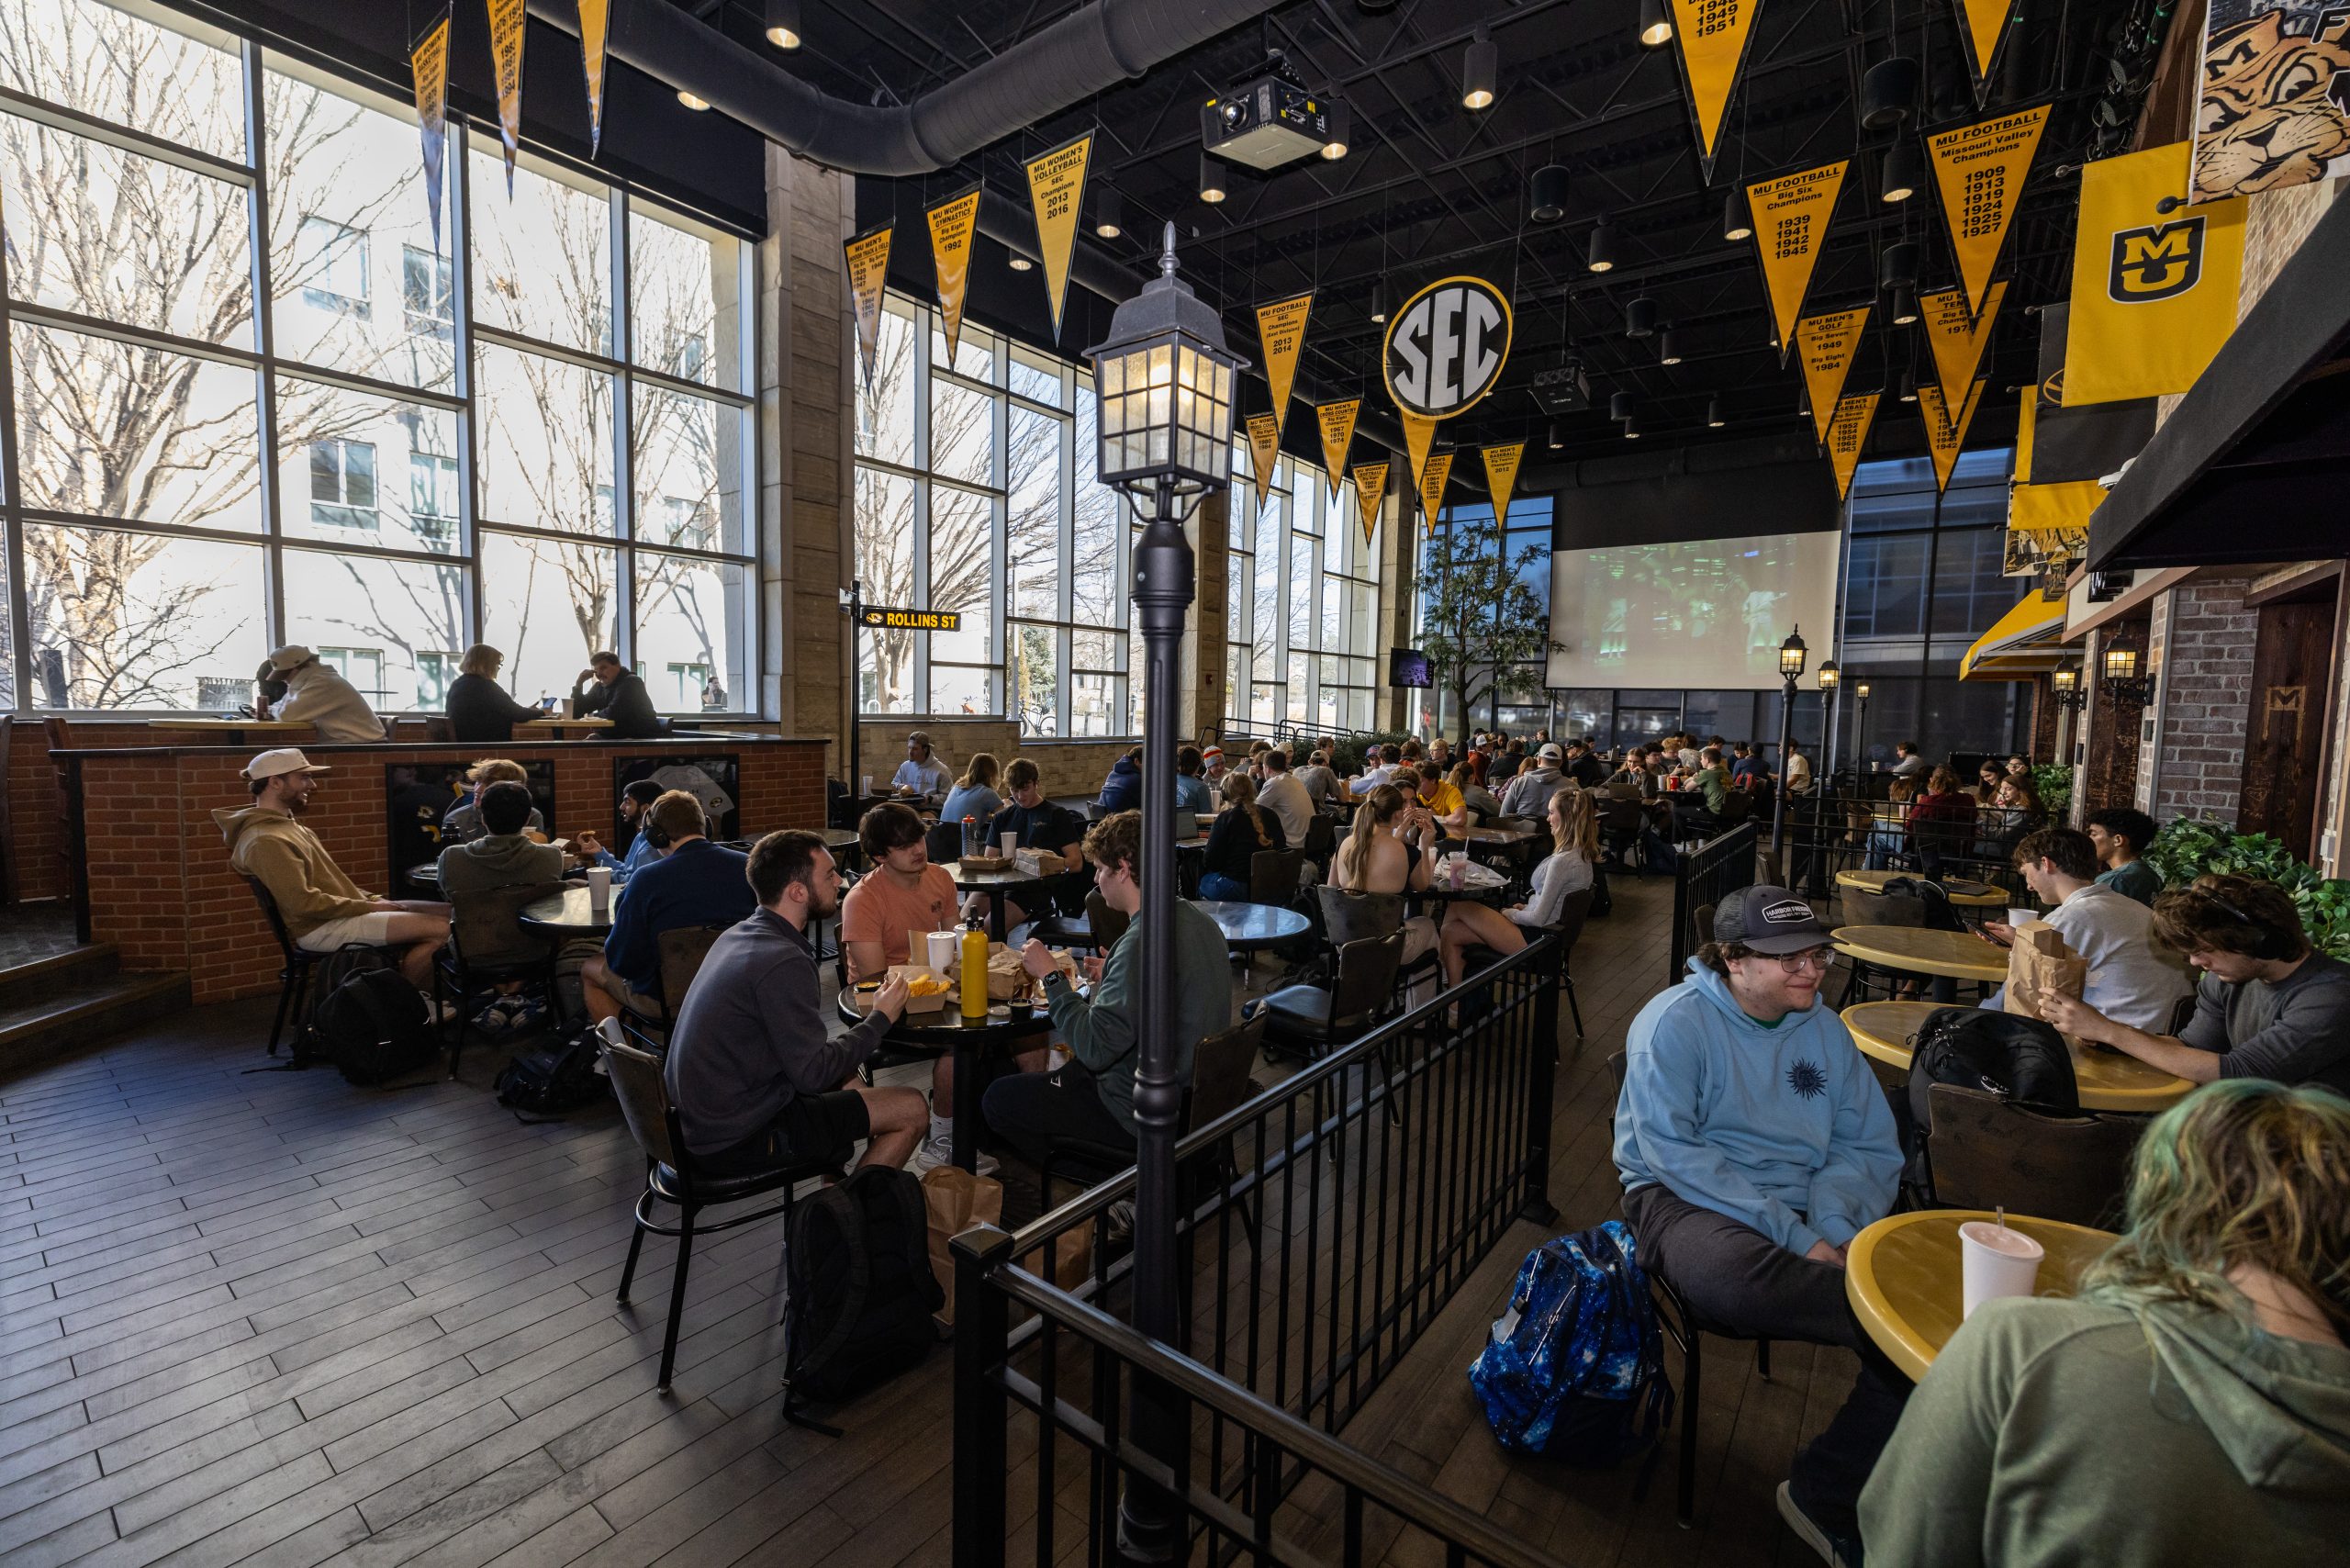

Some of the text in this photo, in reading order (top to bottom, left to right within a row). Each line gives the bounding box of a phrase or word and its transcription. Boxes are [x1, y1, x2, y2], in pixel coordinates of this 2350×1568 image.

[1697, 0, 1737, 15] 194
[1696, 4, 1739, 27] 1949
[1696, 16, 1736, 38] 1951
[1936, 112, 2042, 147] MU FOOTBALL
[1941, 129, 2033, 159] Missouri Valley
[1034, 145, 1083, 174] MU WOMEN'S
[1953, 142, 2020, 164] Champions
[1034, 155, 1083, 182] VOLLEYBALL
[1965, 165, 2006, 183] 1909
[1051, 174, 1064, 185] SEC
[1753, 167, 1841, 196] MU FOOTBALL
[1964, 177, 2005, 195] 1913
[1040, 180, 1075, 199] Champions
[1778, 191, 1794, 199] Big
[1964, 188, 2004, 206] 1919
[1046, 192, 1069, 208] 2013
[1767, 193, 1823, 210] Champions
[933, 198, 973, 220] MU WOMEN'S
[1046, 204, 1069, 219] 2016
[1963, 199, 2003, 217] 1924
[935, 207, 971, 228] GYMNASTICS
[1777, 215, 1810, 230] 1939
[1962, 211, 2002, 228] 1925
[951, 221, 965, 231] Eight
[1777, 225, 1808, 239] 1941
[1961, 222, 2001, 239] 1927
[866, 237, 882, 247] MEN'S
[939, 230, 967, 243] Champions
[1775, 235, 1809, 249] 1942
[944, 240, 962, 252] 1992
[1775, 244, 1808, 260] 1945
[1937, 295, 1953, 303] MU
[1272, 300, 1307, 314] FOOTBALL
[1268, 319, 1298, 330] Champions
[1818, 321, 1842, 330] GOLF
[1825, 313, 1853, 323] MEN'S
[1947, 325, 1968, 334] 197
[1272, 337, 1292, 348] 2013
[1272, 344, 1292, 355] 2014
[1393, 287, 1501, 409] SEC
[1817, 341, 1842, 351] 1949
[1815, 362, 1841, 372] 1984
[887, 612, 957, 629] ROLLINS ST
[1766, 906, 1792, 917] HARBOR
